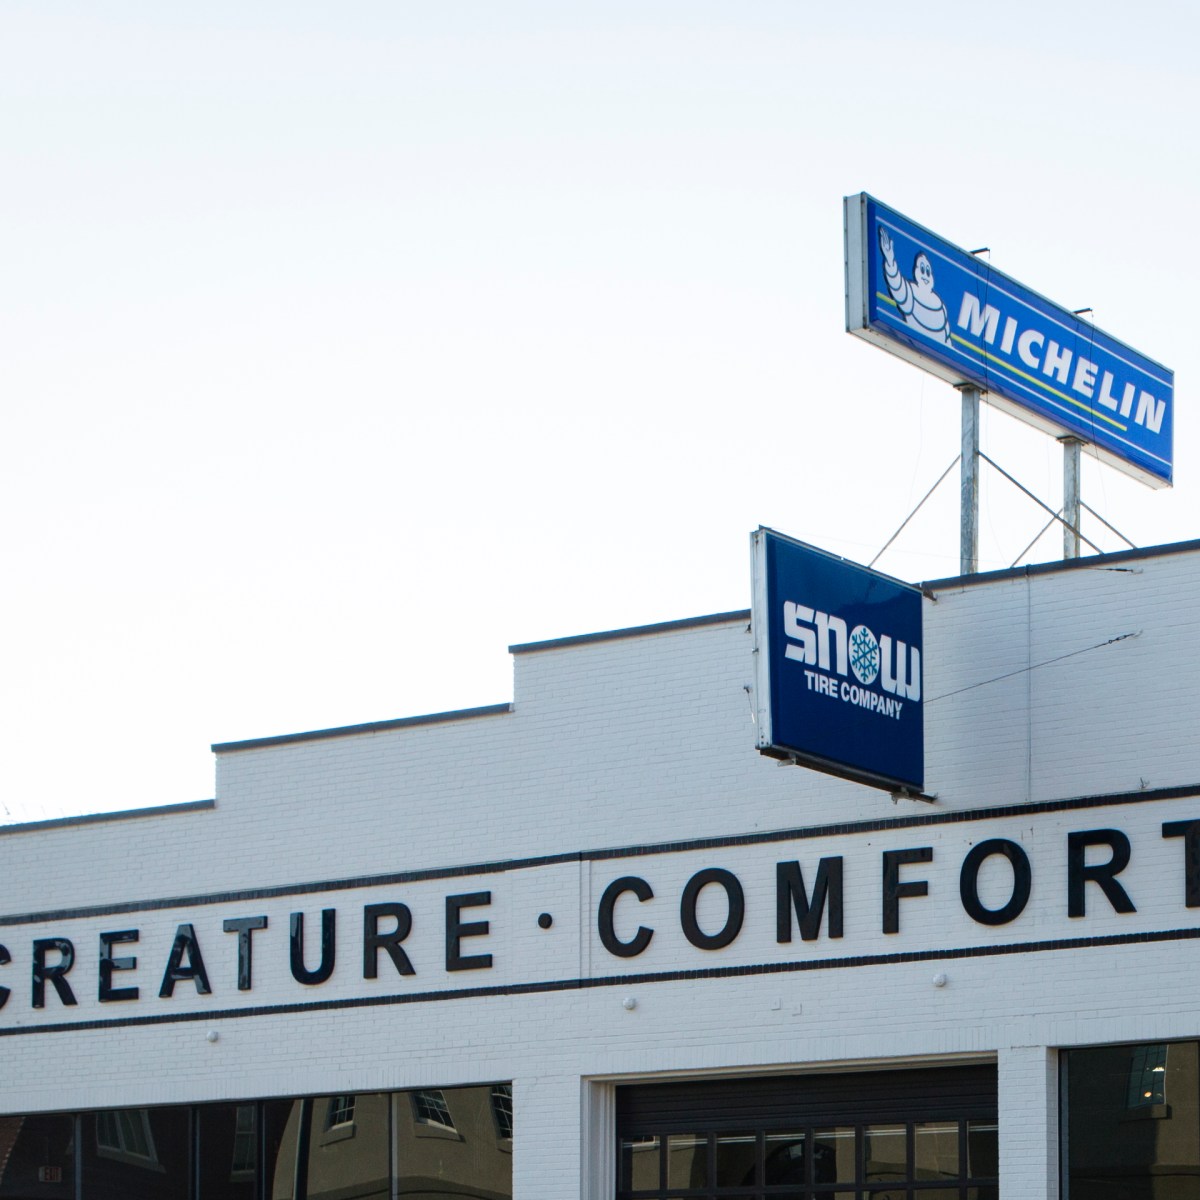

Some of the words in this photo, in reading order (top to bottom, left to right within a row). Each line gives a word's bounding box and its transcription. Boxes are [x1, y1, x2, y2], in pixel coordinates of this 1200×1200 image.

[957, 291, 1166, 434] MICHELIN
[804, 669, 838, 699] TIRE
[840, 681, 903, 720] COMPANY
[0, 890, 493, 1011] REATURE
